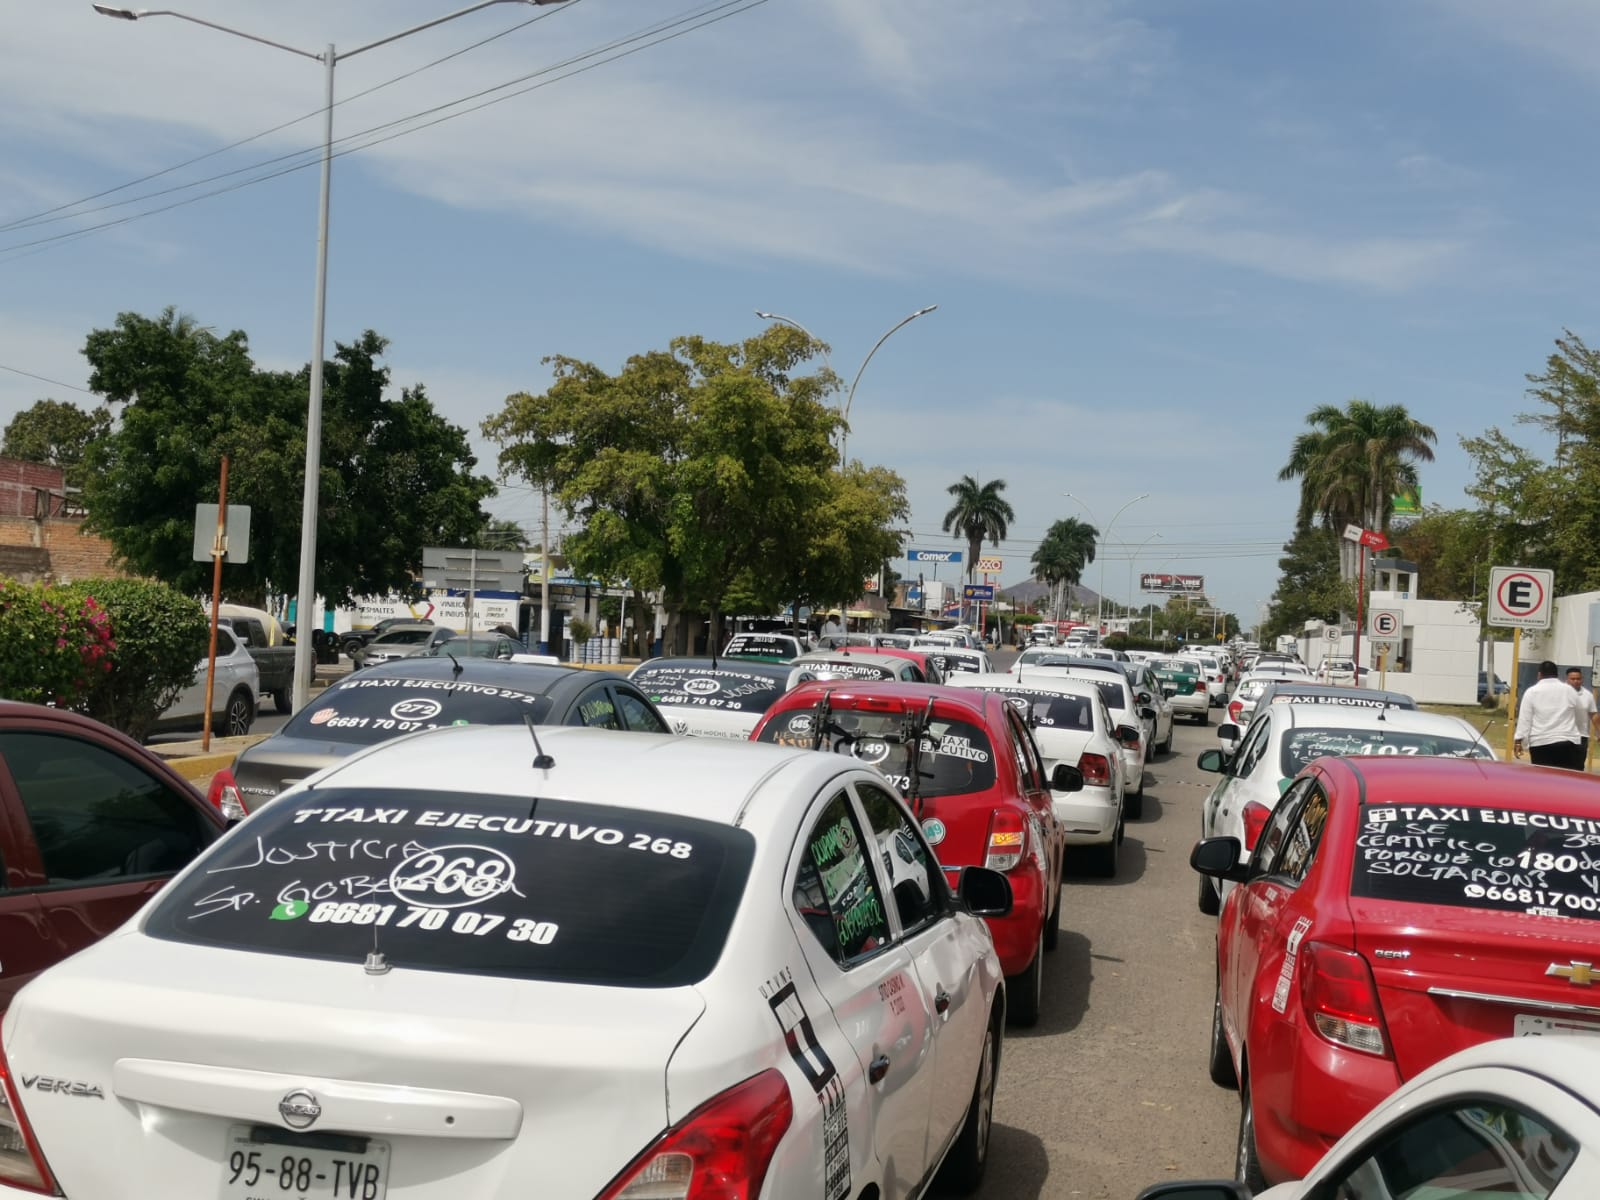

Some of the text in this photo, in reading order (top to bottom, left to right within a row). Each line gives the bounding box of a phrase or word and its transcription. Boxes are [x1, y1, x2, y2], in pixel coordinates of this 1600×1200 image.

[916, 551, 952, 561] Comex
[1508, 580, 1532, 609] E
[1379, 617, 1391, 631] E
[1329, 630, 1336, 639] E
[688, 668, 751, 680] EJECUTIVO
[810, 663, 831, 671] TAXI
[832, 664, 881, 677] EJECUTIVO
[360, 679, 536, 704] TAXI EJECUTIVO 272
[999, 687, 1060, 698] EJECUTIVO
[397, 702, 435, 715] 272
[660, 695, 742, 710] 6681 70 07 30
[1287, 696, 1315, 704] TAXI
[1318, 697, 1385, 708] EJECUTIVO
[327, 717, 366, 728] 6681
[374, 719, 396, 730] 70
[397, 720, 421, 732] 07
[1040, 717, 1055, 725] 30
[941, 734, 970, 748] TAXI
[920, 741, 988, 762] EJCUTIVO
[241, 786, 276, 796] VERSA
[1400, 807, 1470, 822] TAXI
[415, 810, 625, 846] EJECUTIVO
[628, 833, 693, 859] 268
[1363, 822, 1449, 835] SI SE
[1517, 850, 1578, 873] 180
[400, 853, 505, 898] 268
[308, 901, 559, 945] 6681 70 07 30
[1375, 949, 1411, 959] BEAT
[21, 1072, 106, 1101] VERSA
[228, 1150, 381, 1200] 95-88-TVB
